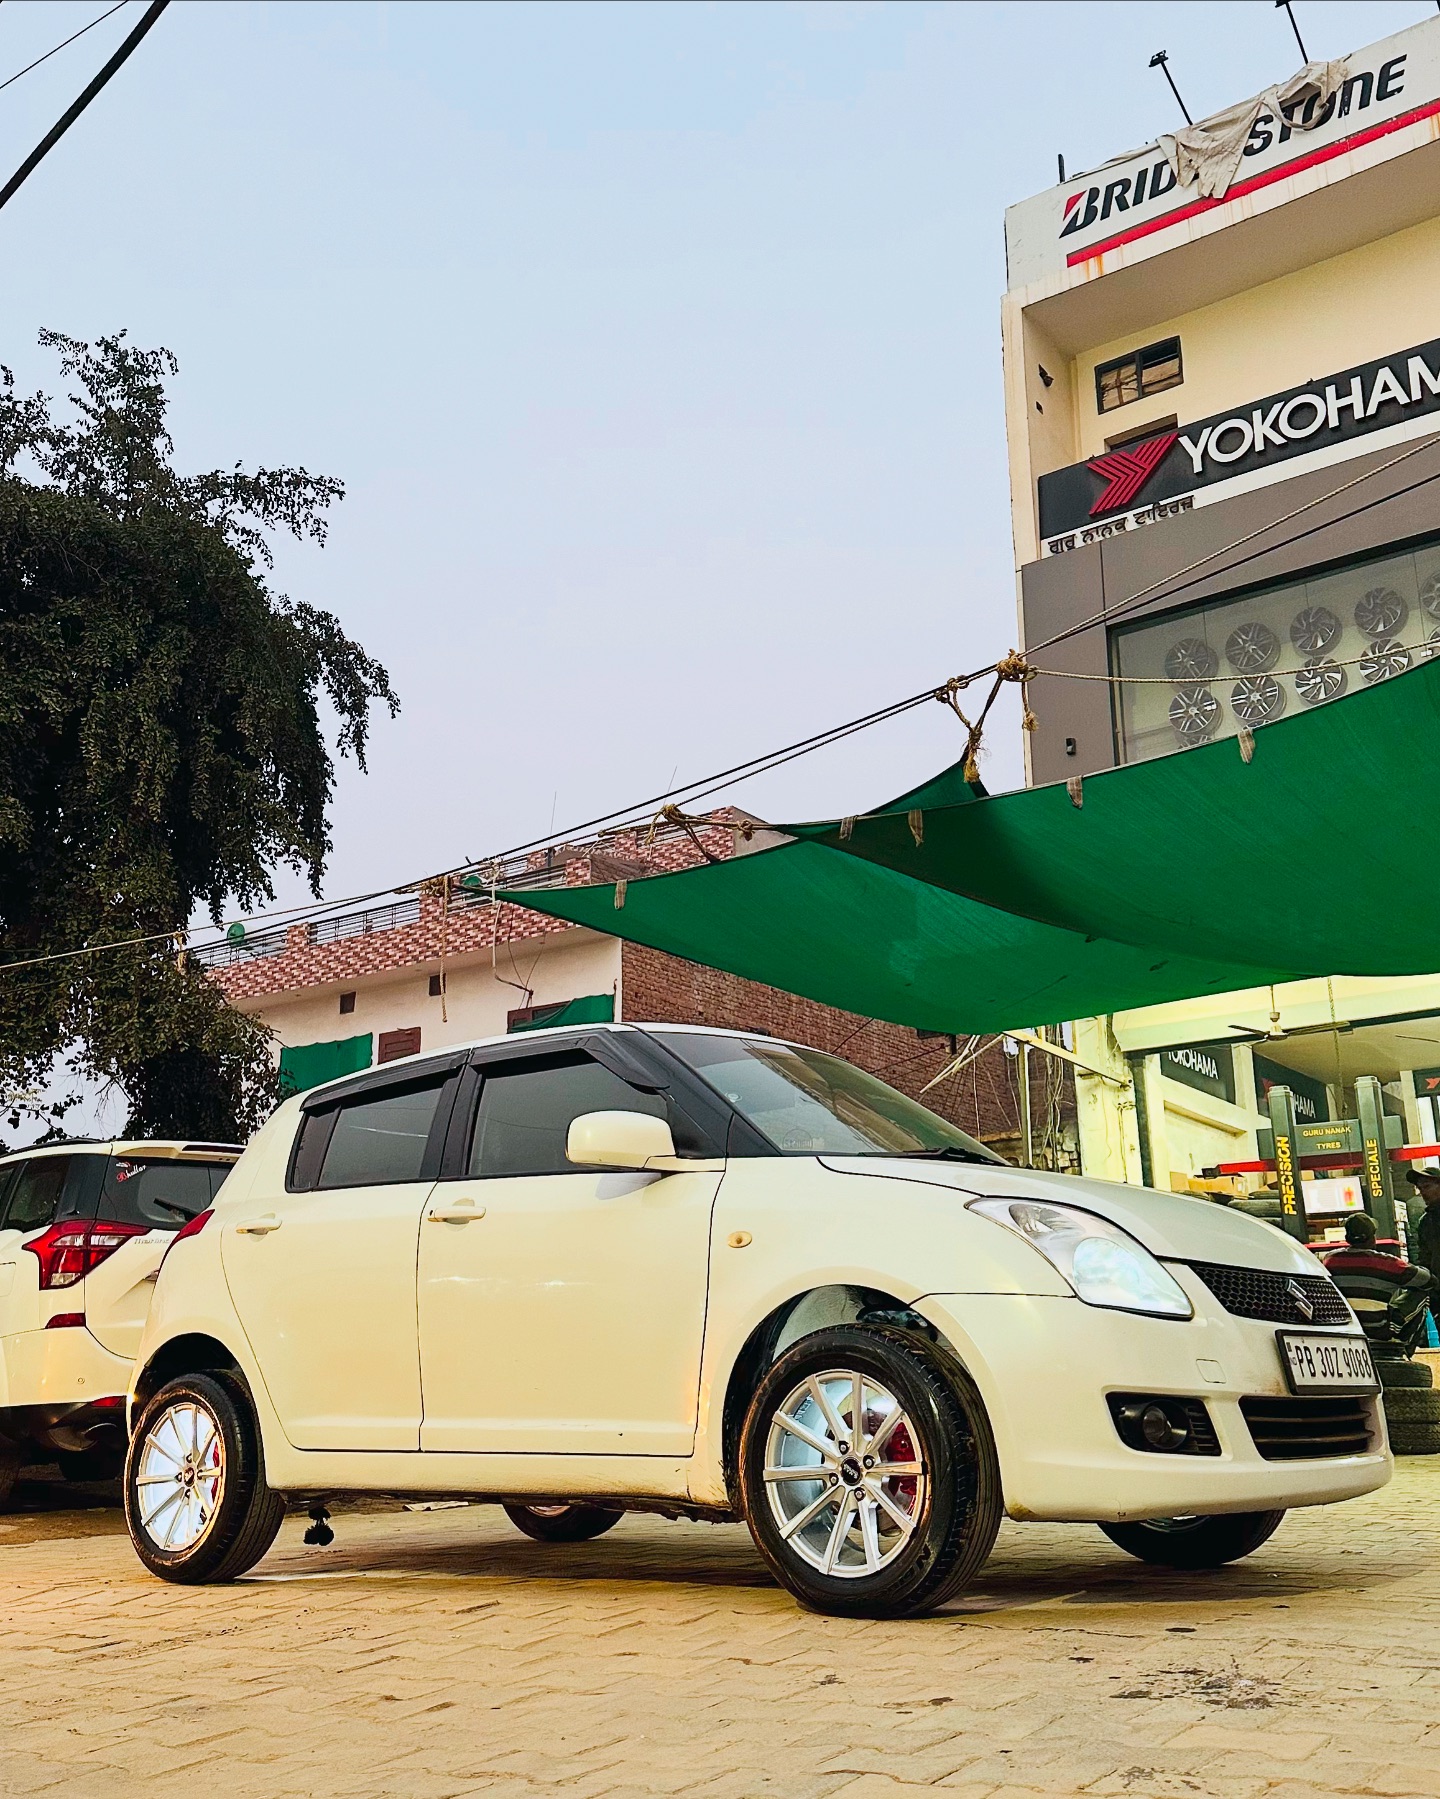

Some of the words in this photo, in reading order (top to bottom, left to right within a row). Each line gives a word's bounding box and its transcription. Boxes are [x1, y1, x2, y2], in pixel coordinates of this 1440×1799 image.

[1058, 54, 1408, 239] BRIDSTONE
[1080, 516, 1127, 544] ਨਾਨਕ
[1302, 1129, 1324, 1137] GURU
[1324, 1126, 1351, 1135] NANAK
[1316, 1141, 1341, 1150] TYRES
[1366, 1138, 1383, 1197] SPECIALE
[1295, 1345, 1316, 1378] PB
[1316, 1346, 1343, 1378] 30Z
[1342, 1347, 1372, 1379] 9088
